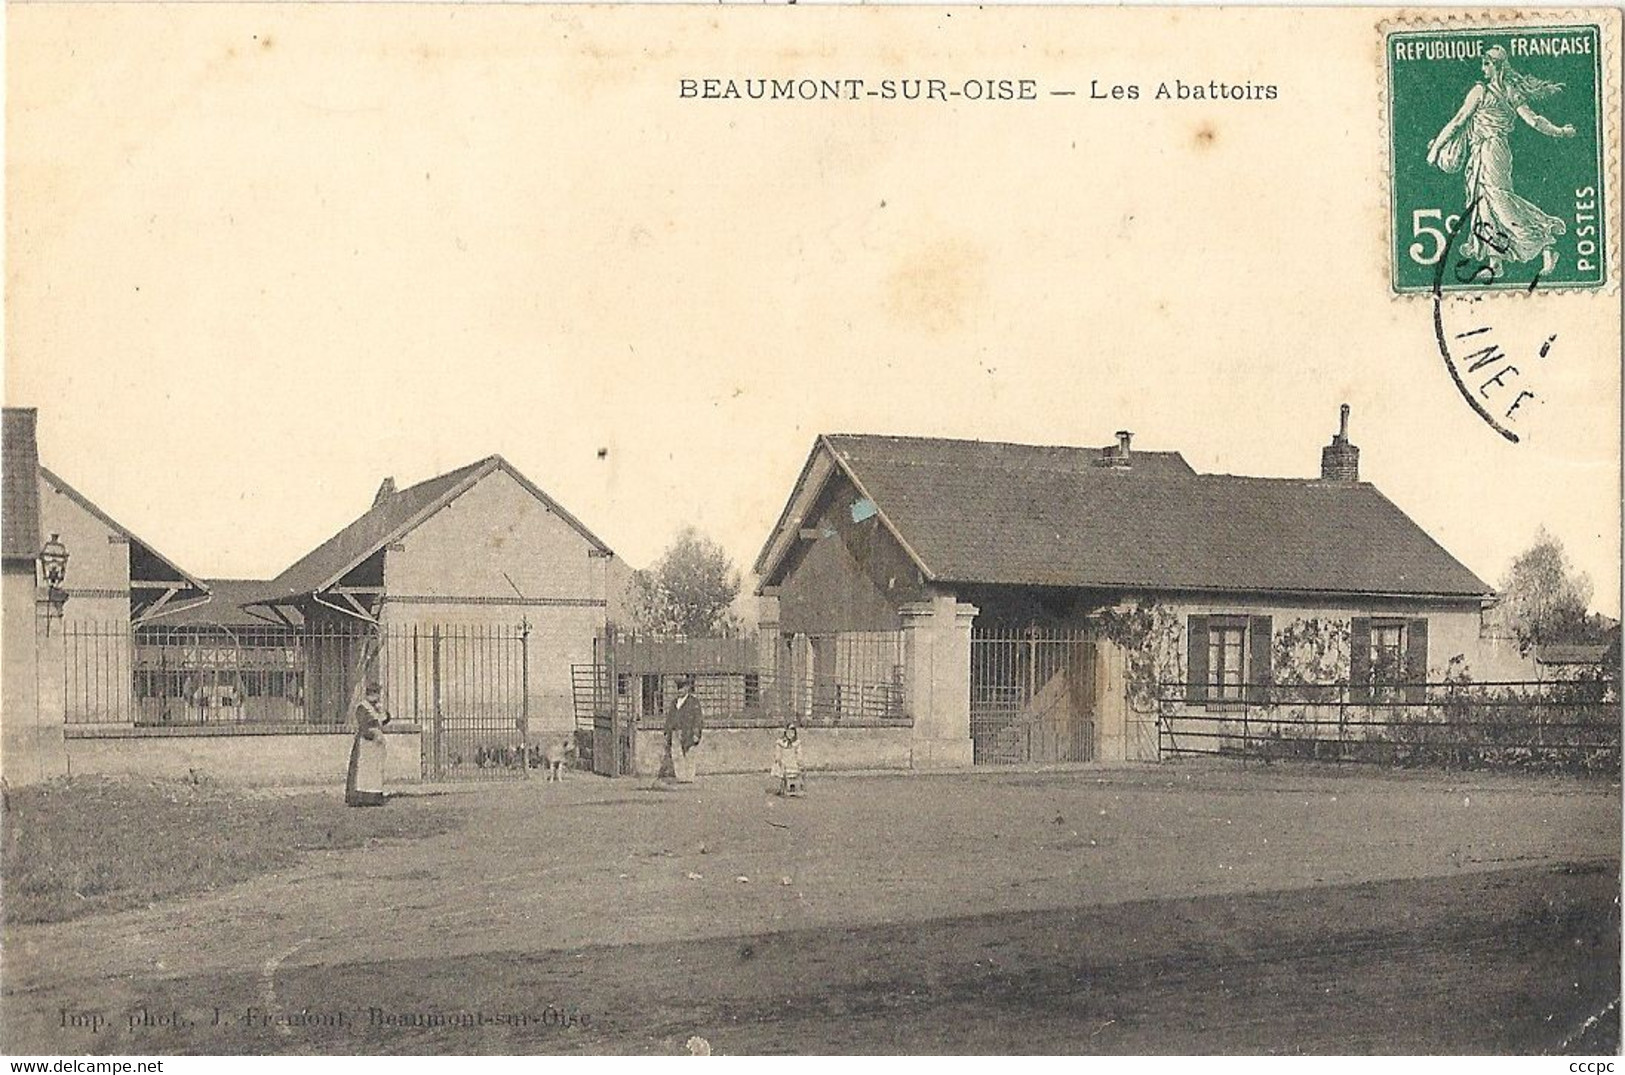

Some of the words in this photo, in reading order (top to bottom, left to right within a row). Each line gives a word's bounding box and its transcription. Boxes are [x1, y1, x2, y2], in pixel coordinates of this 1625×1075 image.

[1395, 40, 1484, 62] REPUBLIQUE
[1510, 36, 1592, 57] FRANÇAISE
[1575, 185, 1596, 272] POSTES
